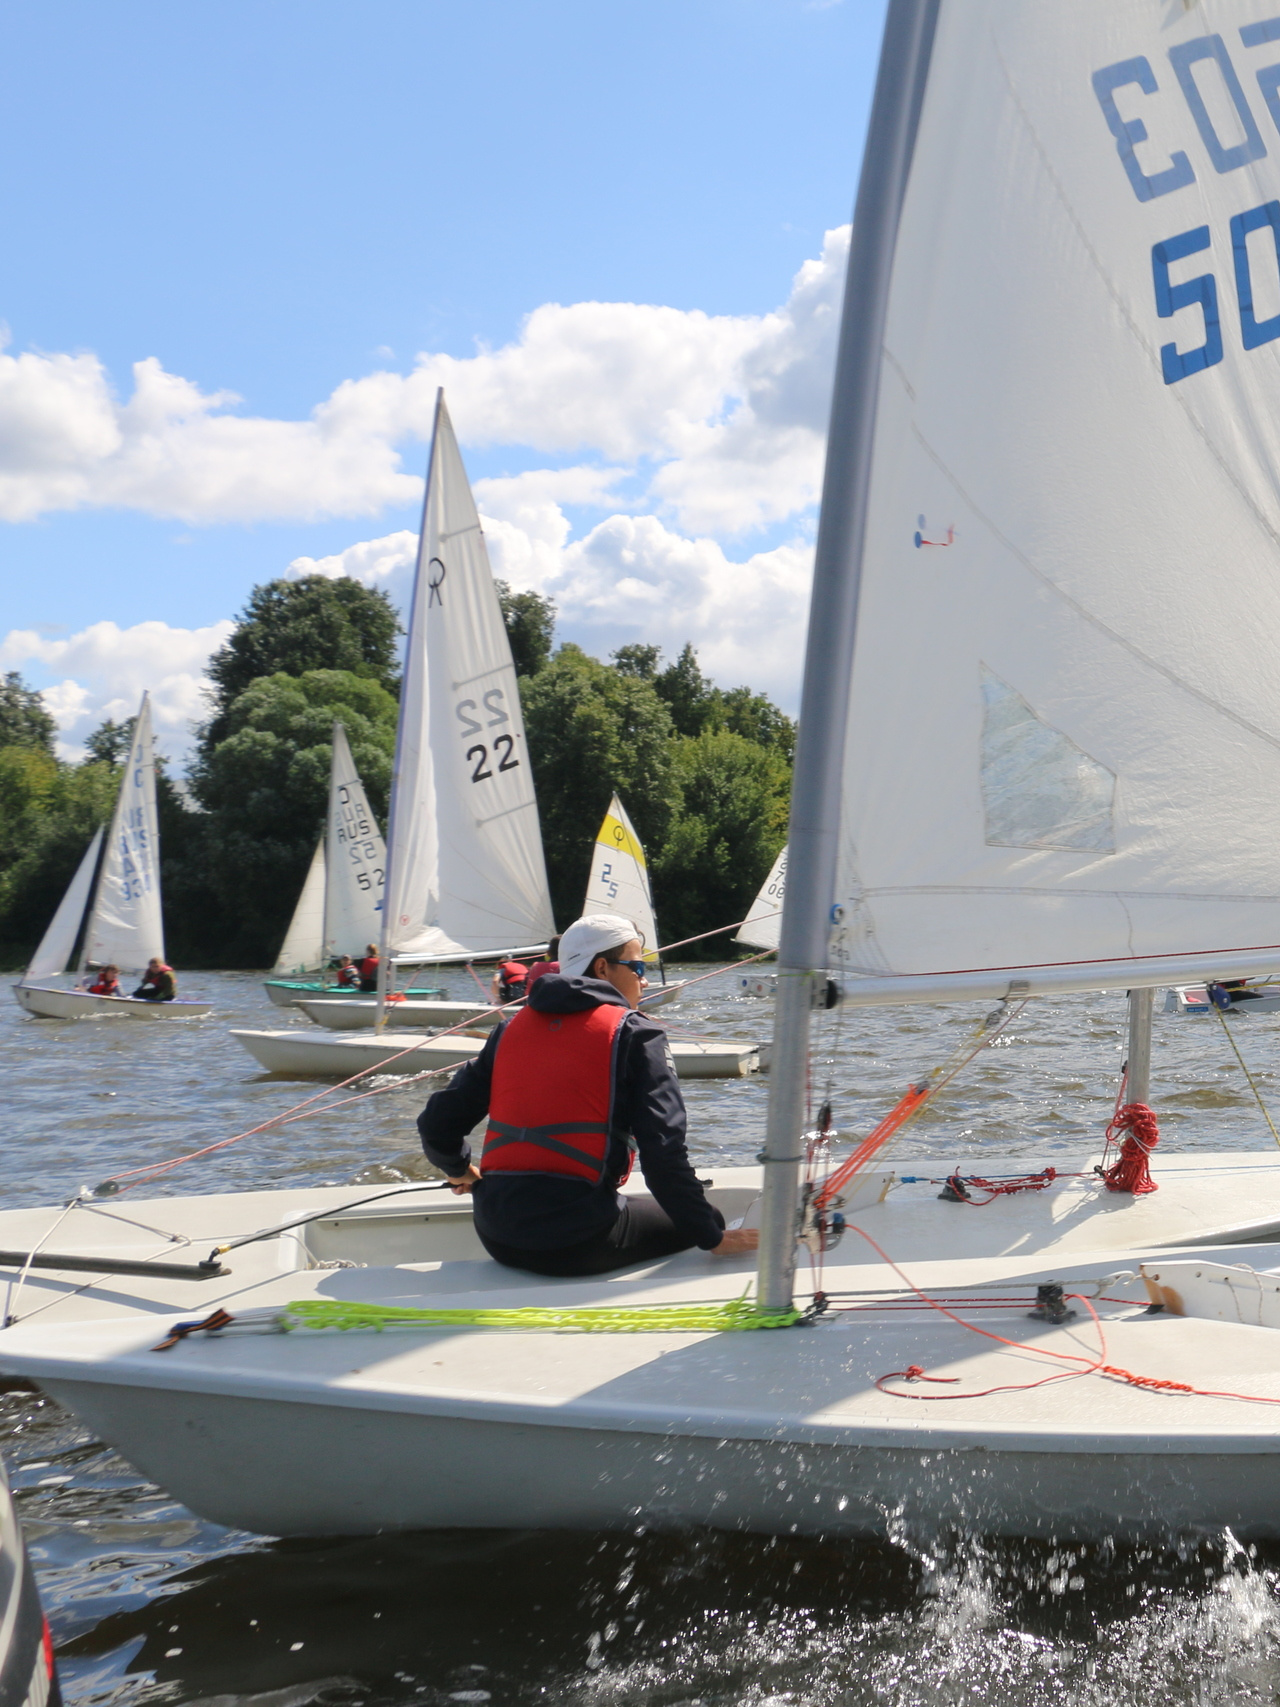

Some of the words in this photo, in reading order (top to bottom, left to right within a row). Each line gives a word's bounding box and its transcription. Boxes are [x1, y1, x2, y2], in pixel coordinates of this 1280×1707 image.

[466, 733, 520, 783] 22
[337, 819, 370, 844] RUS
[356, 868, 386, 892] 52
